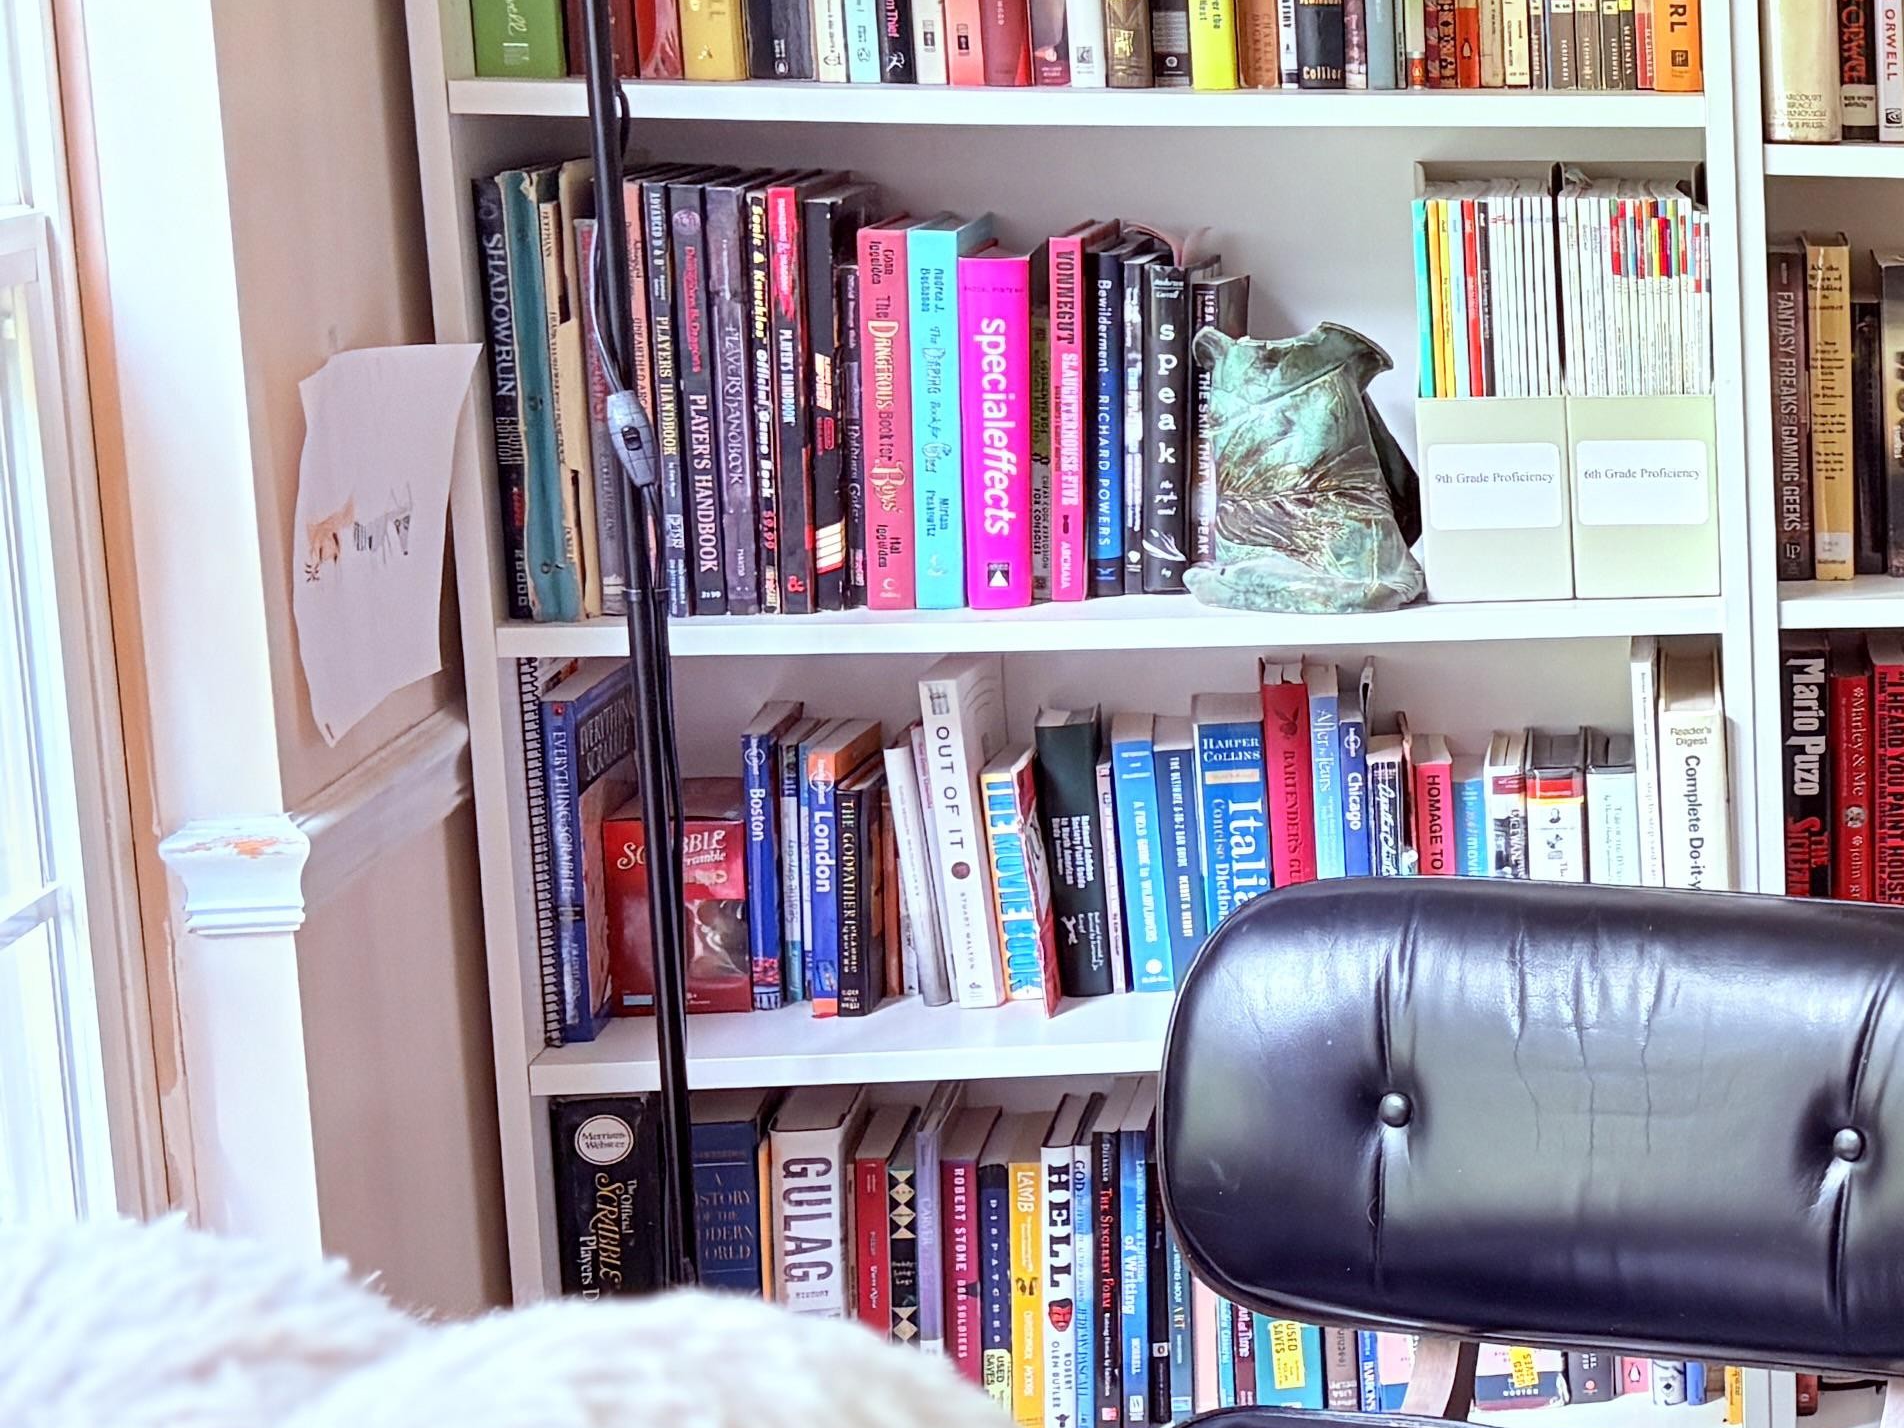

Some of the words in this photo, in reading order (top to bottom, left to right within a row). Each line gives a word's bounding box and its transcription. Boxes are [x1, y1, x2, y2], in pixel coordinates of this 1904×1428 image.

[482, 234, 517, 396] SHADOWRUN
[1054, 250, 1075, 345] VONNEGUT
[1097, 279, 1113, 373] Bewilderment
[1780, 363, 1798, 416] FREAKS
[1097, 394, 1110, 471] RICHARD
[1435, 473, 1453, 485] 9th
[1456, 472, 1489, 485] Grade
[1492, 471, 1554, 486] Proficiency
[1583, 468, 1601, 480] 6th
[1604, 467, 1636, 480] Grade
[1640, 467, 1702, 481] Proficiency
[693, 476, 718, 572] HANDBOOK
[1097, 477, 1111, 546] POWERS
[1783, 485, 1801, 532] GEEKS
[1788, 658, 1826, 732] Mario
[936, 726, 955, 774] OUT
[1789, 736, 1826, 796] Puzo
[749, 788, 765, 841] Boston
[944, 787, 960, 816] OF
[1346, 772, 1363, 831] Chicago
[1427, 774, 1443, 845] HOMAGE
[1684, 755, 1701, 835] Complete
[812, 810, 831, 894] London
[1430, 848, 1444, 870] TO
[782, 1156, 834, 1285] GULAG
[953, 1168, 966, 1217] ROBERT
[954, 1221, 968, 1272] STONE
[1047, 1162, 1072, 1288] HELL
